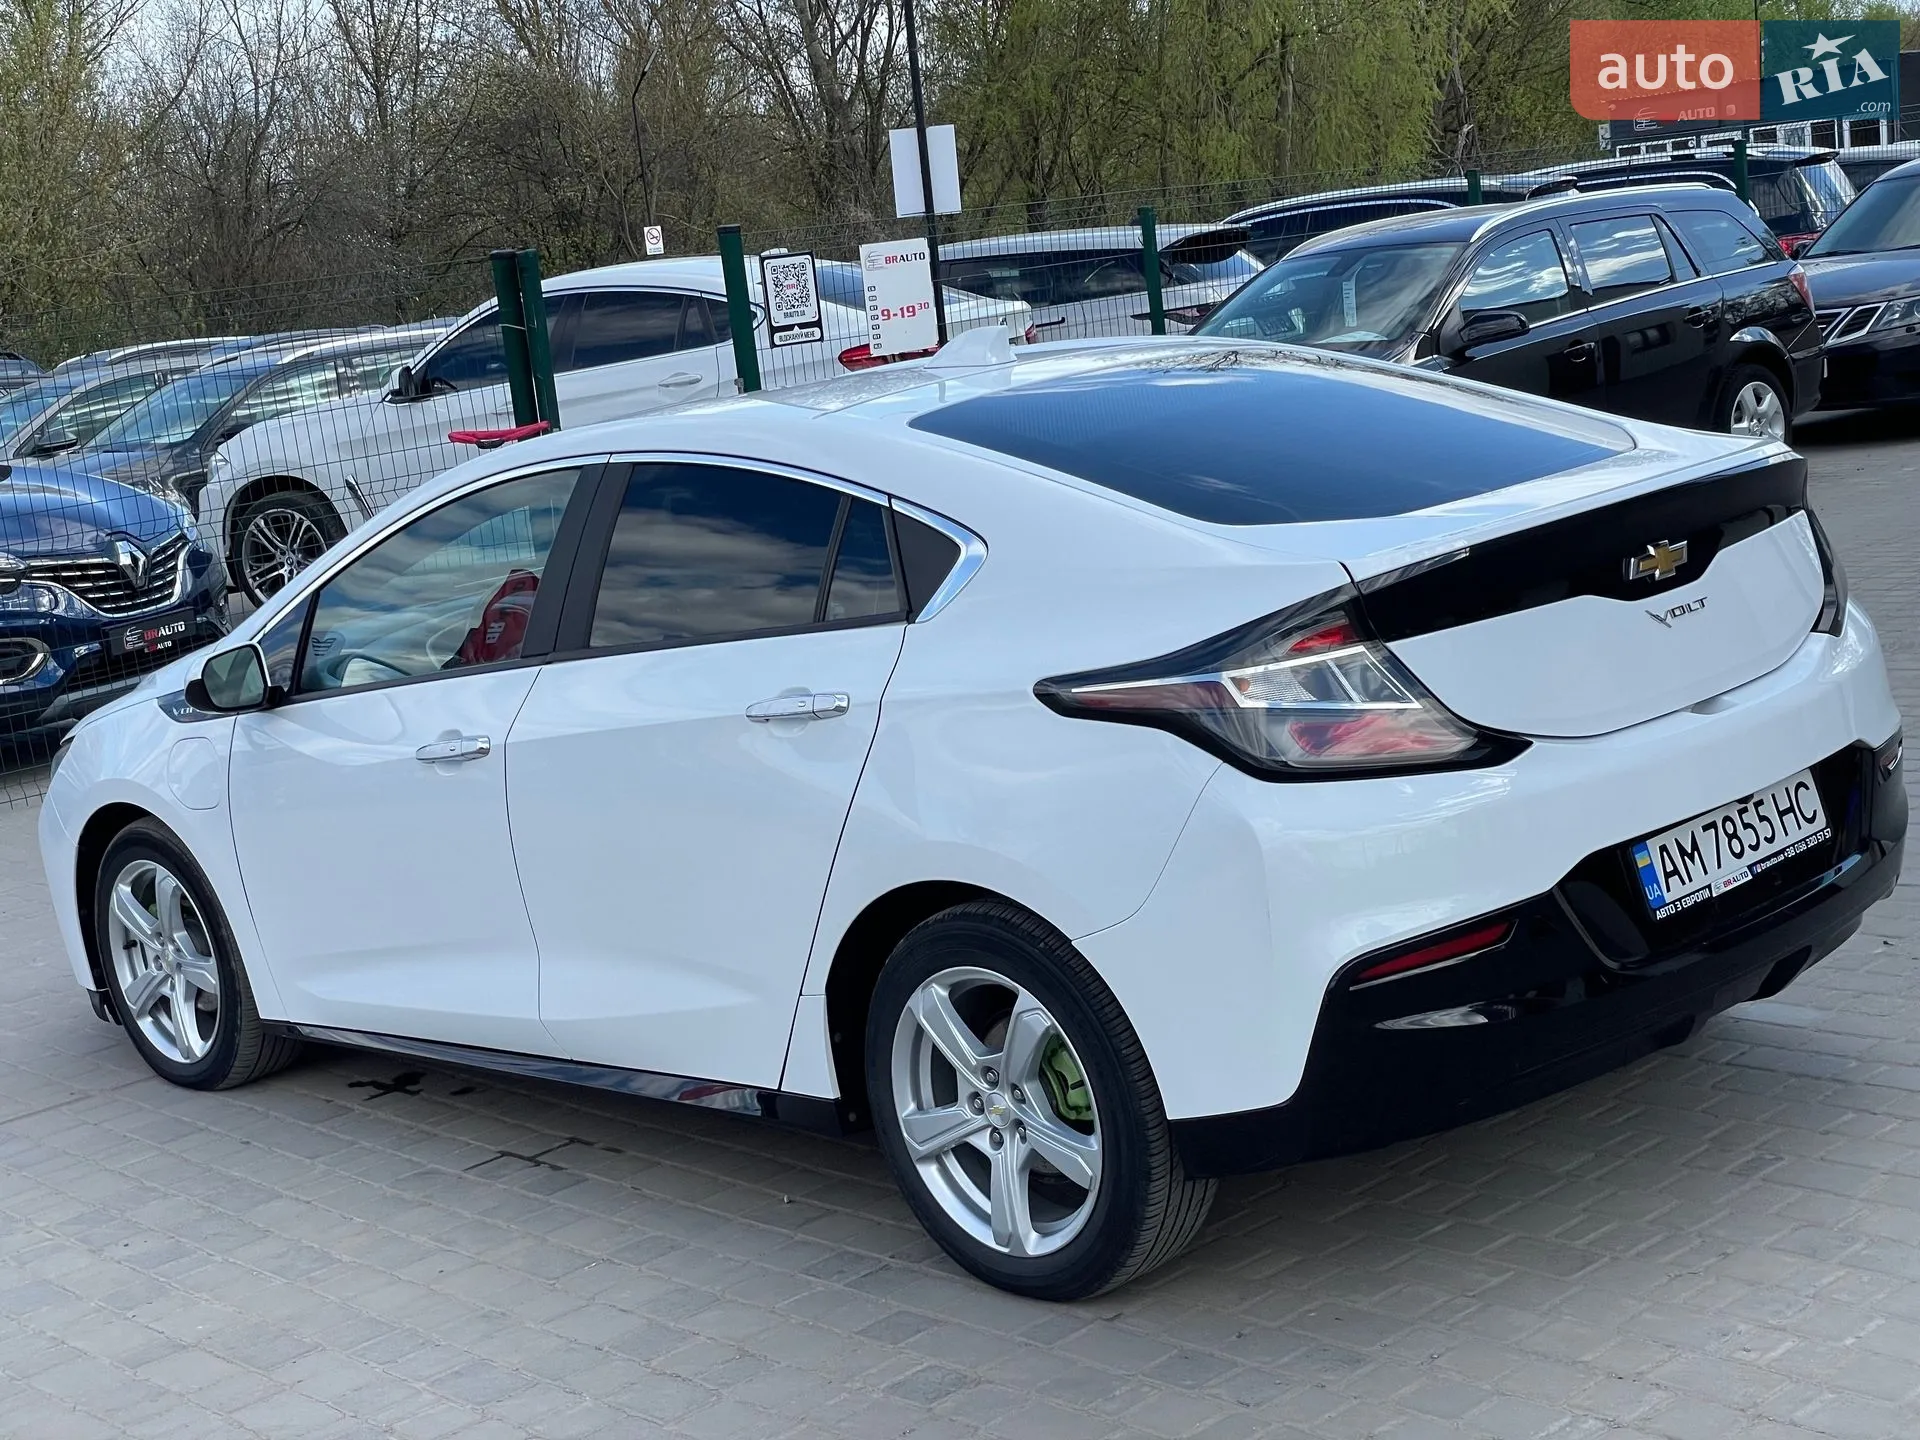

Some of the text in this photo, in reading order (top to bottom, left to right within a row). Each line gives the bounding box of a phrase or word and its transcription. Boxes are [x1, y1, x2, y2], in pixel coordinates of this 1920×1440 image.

[884, 251, 926, 265] BRAUTO
[1644, 596, 1708, 629] VOLT
[1722, 870, 1749, 888] BRAUTO
[1645, 883, 1662, 900] UA
[1656, 904, 1676, 920] АВТО
